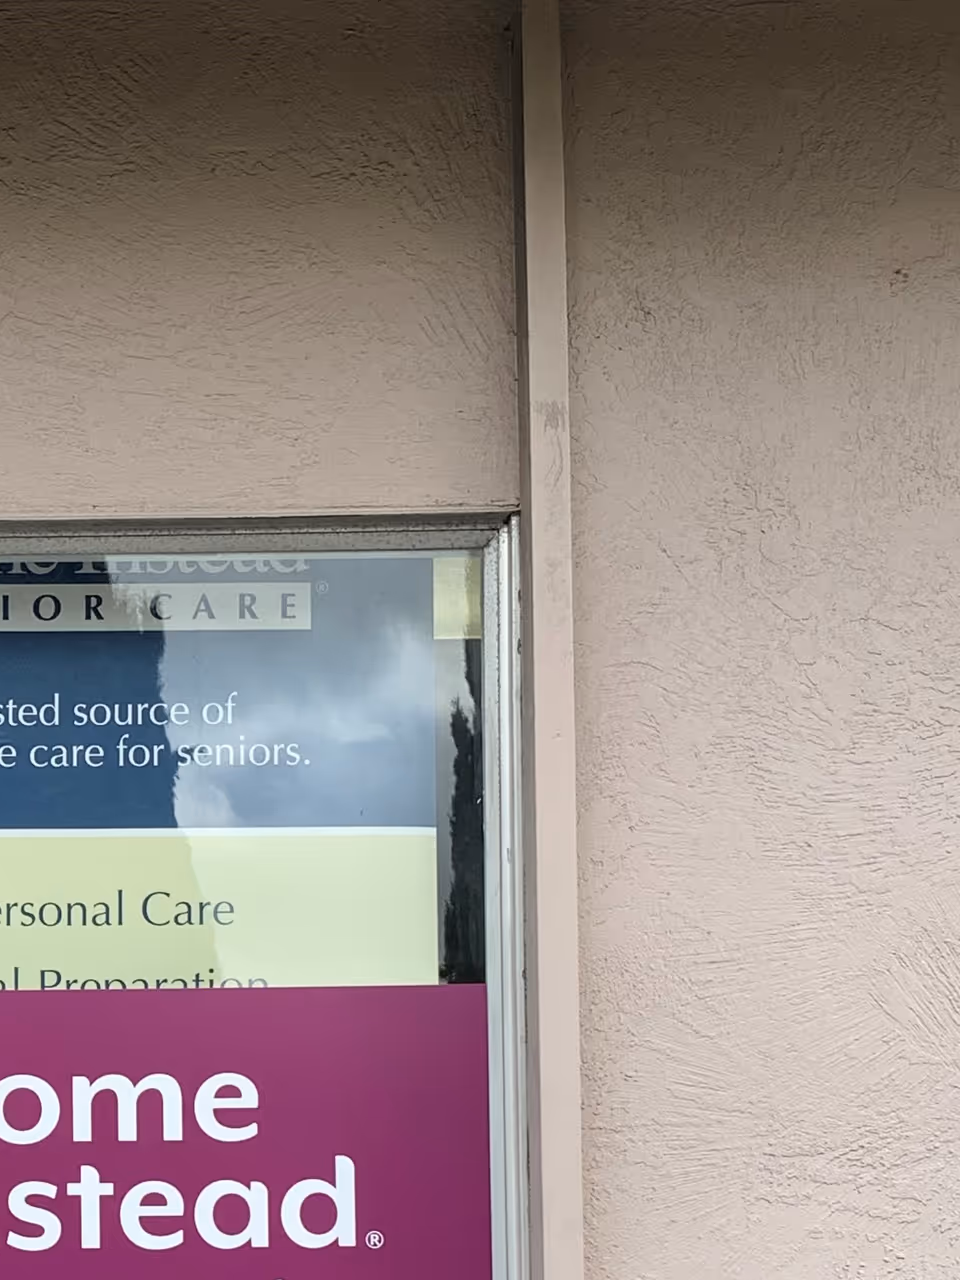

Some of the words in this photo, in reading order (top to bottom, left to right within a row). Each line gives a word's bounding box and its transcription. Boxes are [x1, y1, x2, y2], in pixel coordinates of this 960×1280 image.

[150, 592, 297, 621] CARE
[73, 700, 190, 726] source
[201, 692, 238, 725] of
[29, 743, 105, 767] care
[116, 735, 165, 766] for
[177, 735, 311, 766] seniors.
[141, 891, 235, 926] Care
